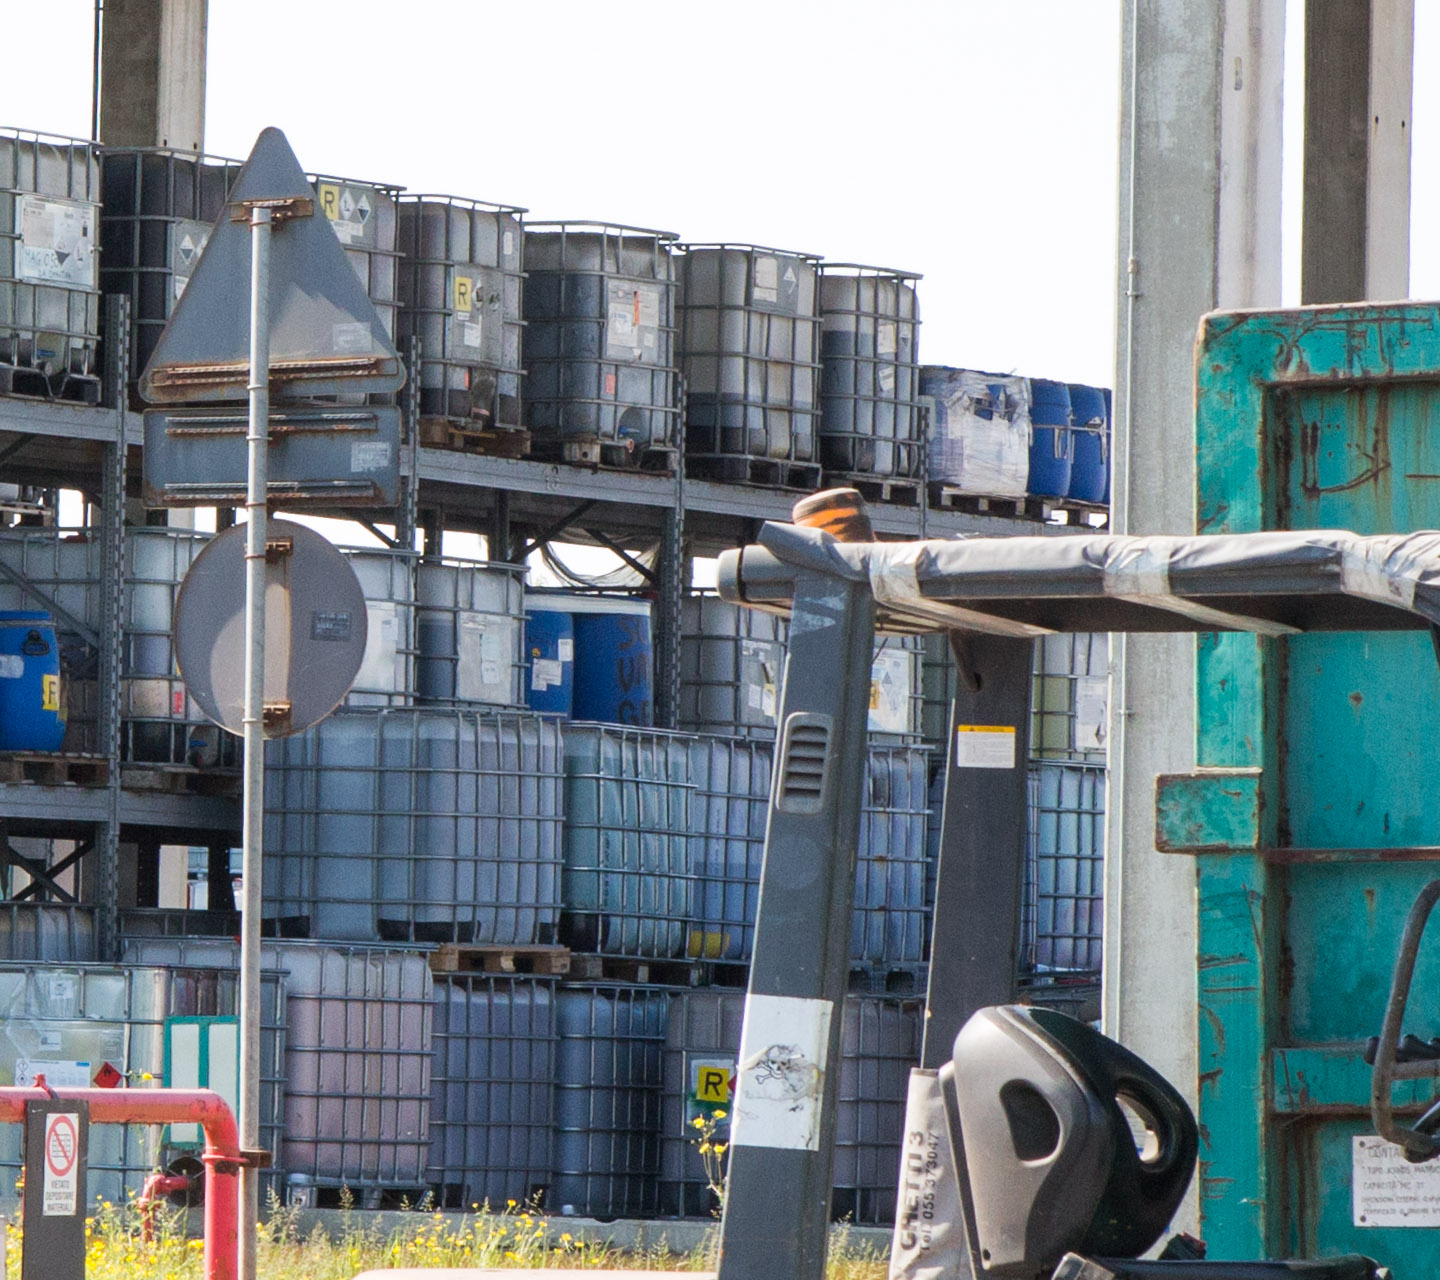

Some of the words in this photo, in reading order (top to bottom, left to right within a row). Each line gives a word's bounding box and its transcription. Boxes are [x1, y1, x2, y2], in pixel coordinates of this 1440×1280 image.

[325, 191, 335, 214] R
[458, 283, 467, 306] R
[704, 1072, 723, 1096] R
[925, 1131, 940, 1189] 373047
[922, 1192, 935, 1220] 055
